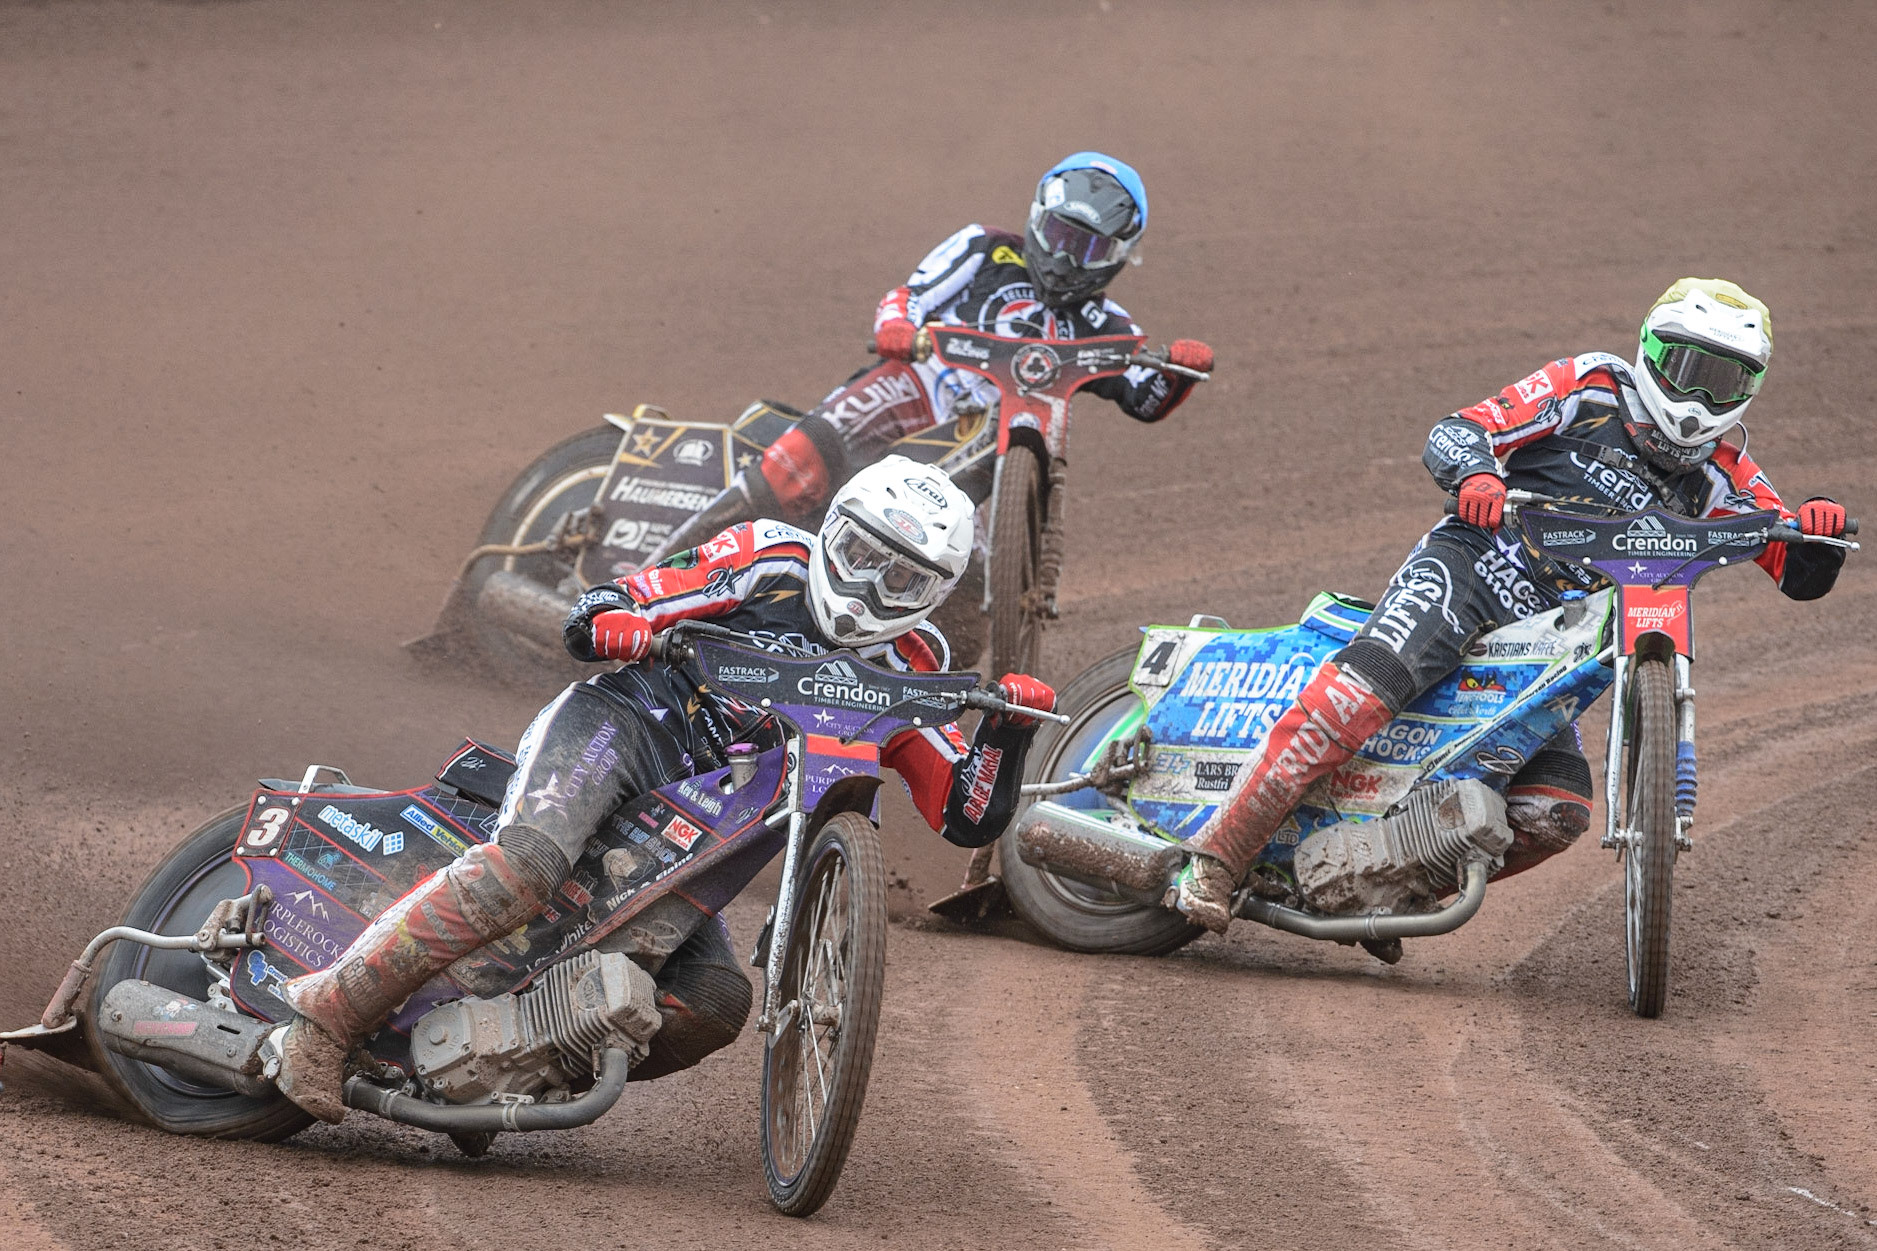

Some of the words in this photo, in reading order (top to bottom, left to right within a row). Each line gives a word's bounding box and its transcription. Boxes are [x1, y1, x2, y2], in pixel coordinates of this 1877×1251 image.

[1657, 440, 1682, 458] LIFTS
[912, 480, 945, 505] Arai
[1569, 450, 1654, 512] Crend
[1583, 472, 1617, 501] TIMBER
[1542, 529, 1585, 541] FASTRACK
[1611, 533, 1698, 552] Crendon
[1707, 530, 1746, 541] FASTRA
[1652, 550, 1697, 558] ENGINEERING
[1368, 575, 1444, 654] LIFTS
[1627, 606, 1676, 618] MERIDIAN
[1635, 617, 1664, 628] LIFTS
[1141, 641, 1178, 675] 4
[1488, 641, 1532, 658] KRISTIANS
[718, 665, 767, 677] FASTRACK
[797, 676, 891, 707] Crendon
[814, 696, 841, 706] TIMBER
[825, 721, 842, 730] CITY
[844, 724, 875, 734] AUCION
[1190, 702, 1284, 739] LIFTS
[1247, 662, 1374, 814] MERIDIAN
[1360, 736, 1431, 761] HOCKS
[564, 763, 590, 798] CITY
[581, 721, 618, 766] AUCTION
[591, 747, 619, 786] GROUP
[1197, 763, 1228, 777] LARS
[1230, 764, 1243, 777] BR
[1197, 777, 1229, 791] Rustfri
[1331, 769, 1383, 794] NGK
[677, 780, 693, 798] Kev
[698, 793, 722, 818] Leigh
[245, 807, 290, 848] 3
[317, 804, 384, 853] metaskil
[404, 806, 435, 833] Allied
[667, 817, 700, 844] NGK
[284, 851, 337, 892] THERMOHOME
[606, 886, 637, 912] Nick
[268, 898, 344, 960] RPLEROCK
[263, 917, 326, 969] OGISTICS
